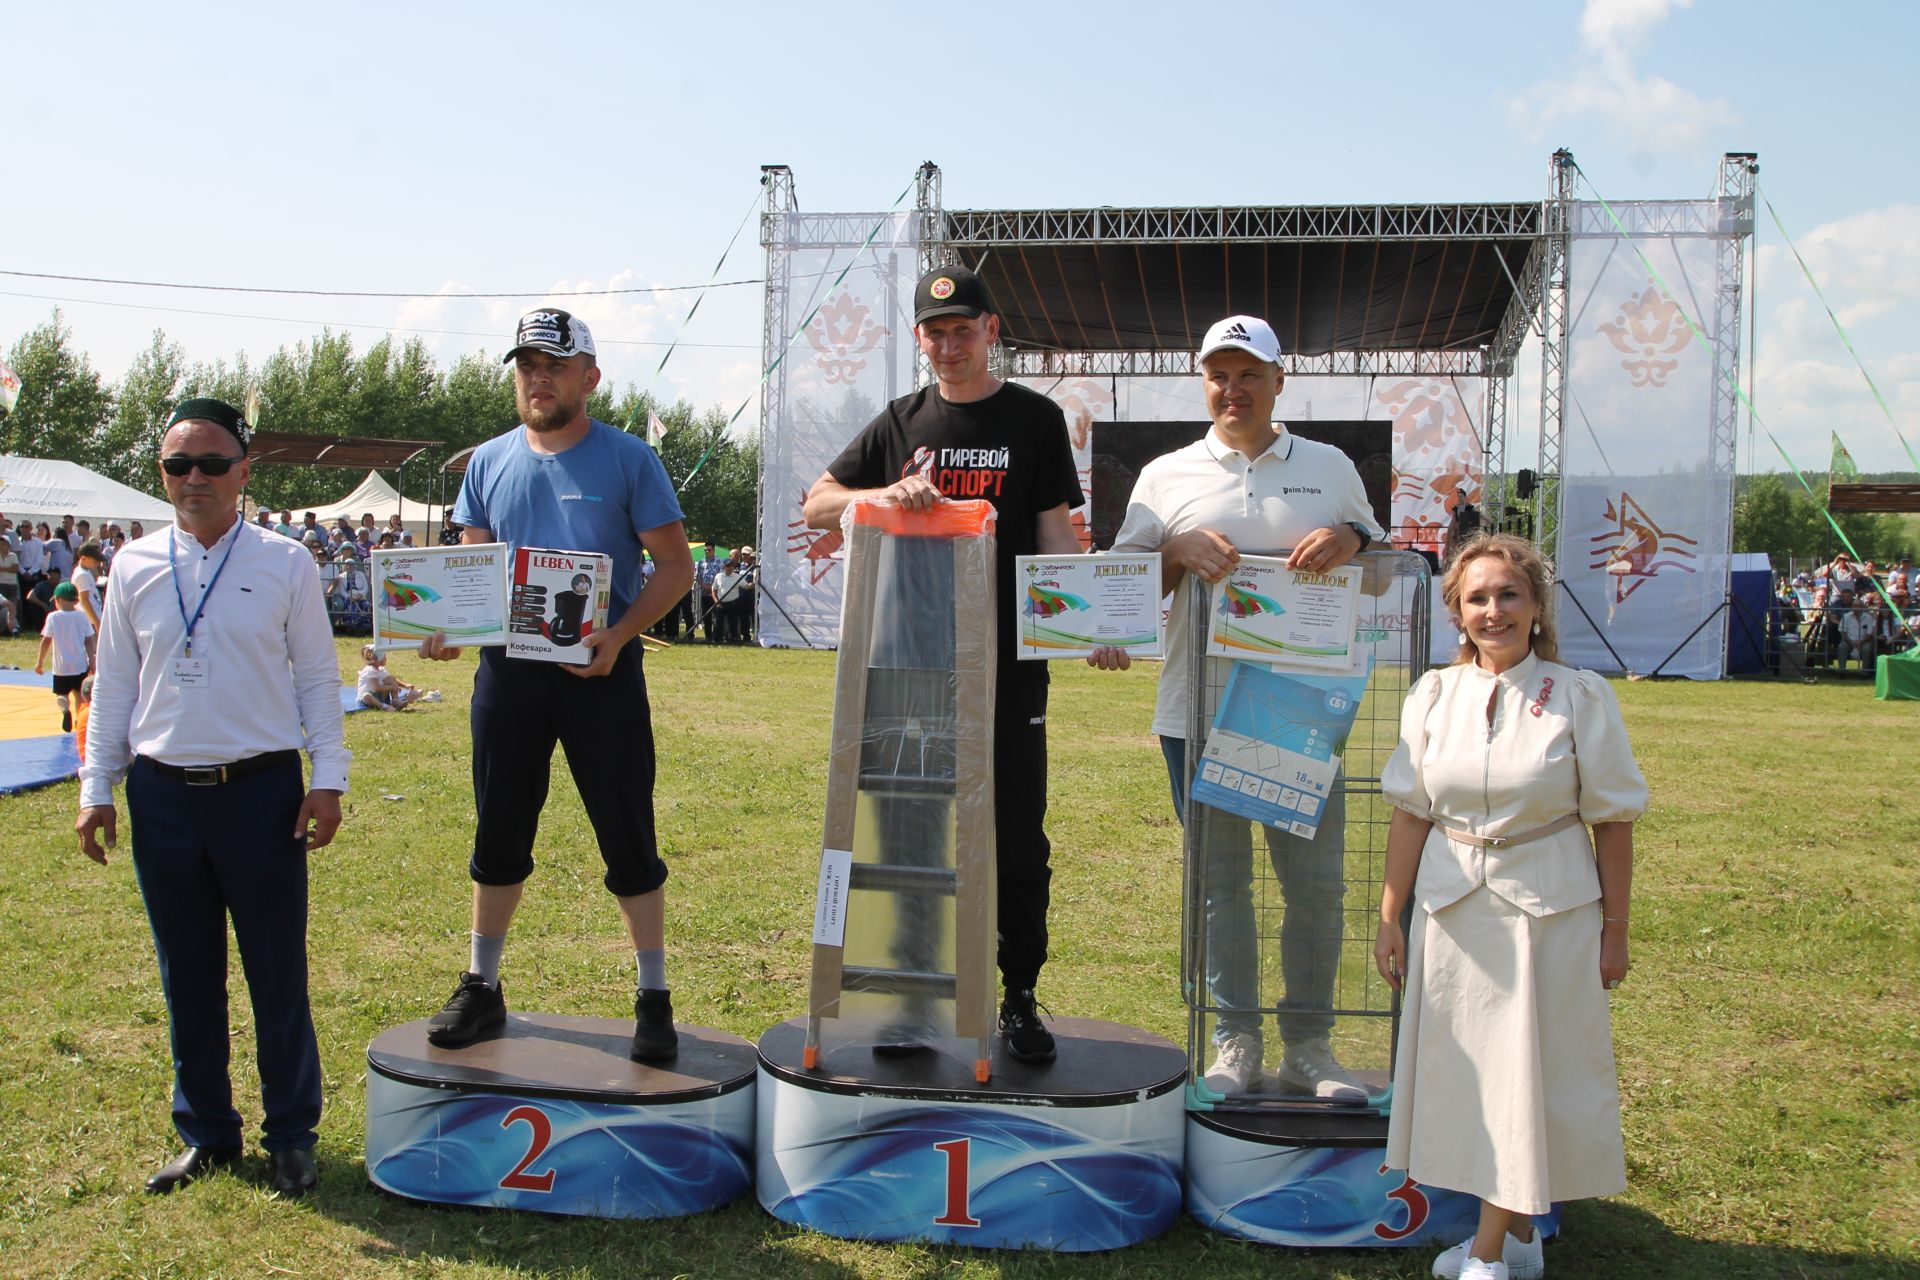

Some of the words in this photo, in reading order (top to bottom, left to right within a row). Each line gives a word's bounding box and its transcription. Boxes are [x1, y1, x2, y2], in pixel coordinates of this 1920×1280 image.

[1220, 333, 1251, 342] adidas
[940, 446, 1009, 468] ГИРЕВОЙ
[939, 469, 1008, 496] СПОРТ
[444, 554, 495, 571] ДИПЛОМ
[533, 556, 574, 571] LEBEN
[1094, 564, 1149, 579] ДИПЛОМ
[1292, 572, 1348, 589] ДИПЛОМ
[510, 642, 552, 653] Кофеварка
[1296, 771, 1307, 783] 18
[832, 875, 840, 904] ГИРЕВОЙ
[498, 1105, 556, 1193] 2
[933, 1137, 981, 1227] 1
[1374, 1163, 1430, 1242] 3
